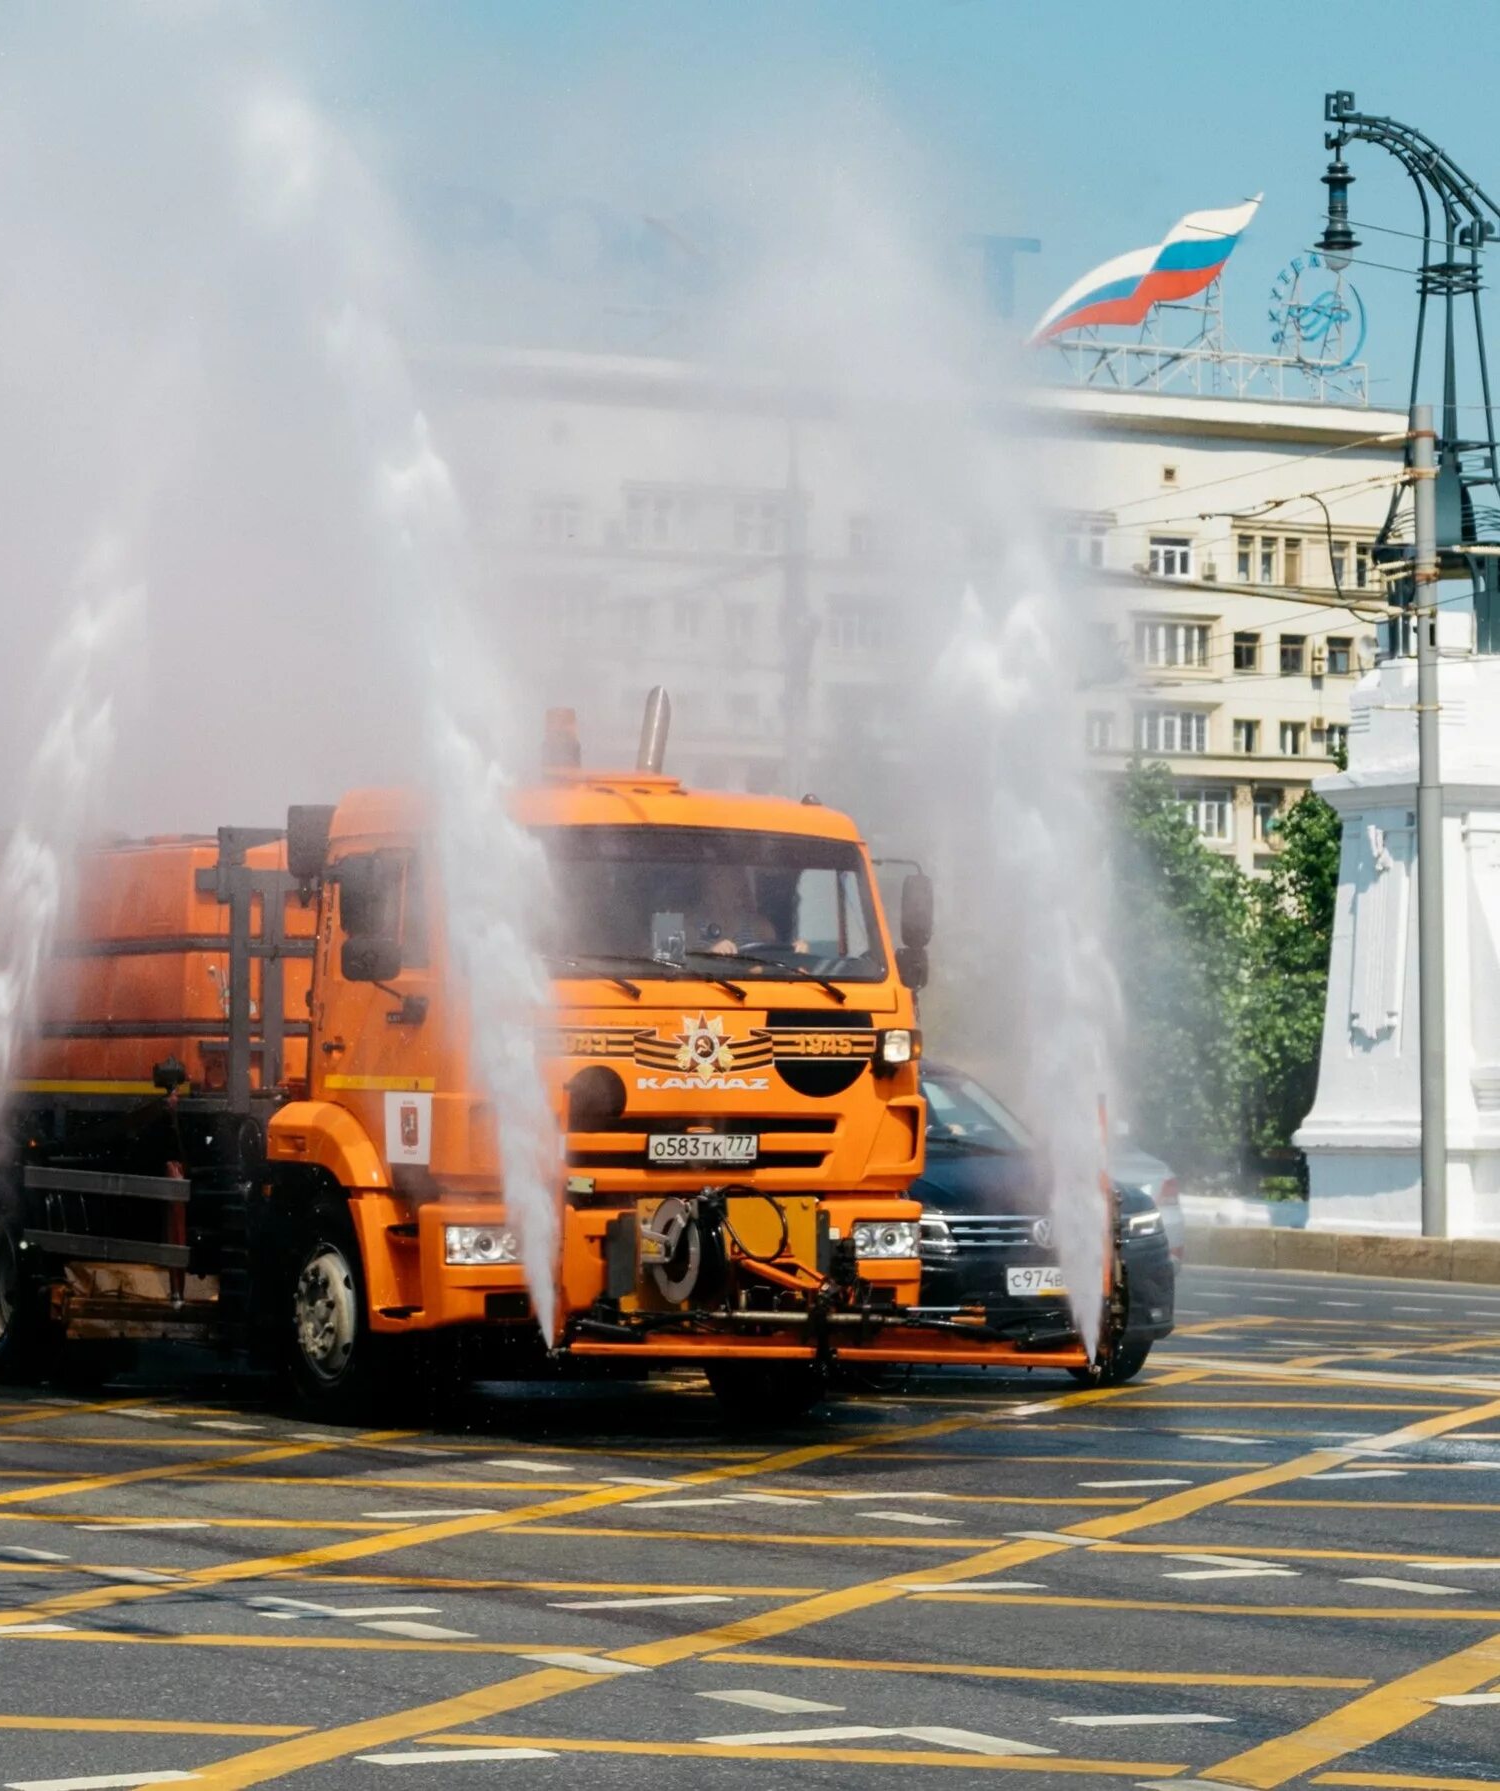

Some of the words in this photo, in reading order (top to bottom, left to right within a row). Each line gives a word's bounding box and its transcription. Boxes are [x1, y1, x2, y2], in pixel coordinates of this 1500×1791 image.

[1268, 253, 1321, 344] SKYTEA
[795, 1033, 853, 1055] 1945
[637, 1077, 769, 1090] KAMAZ
